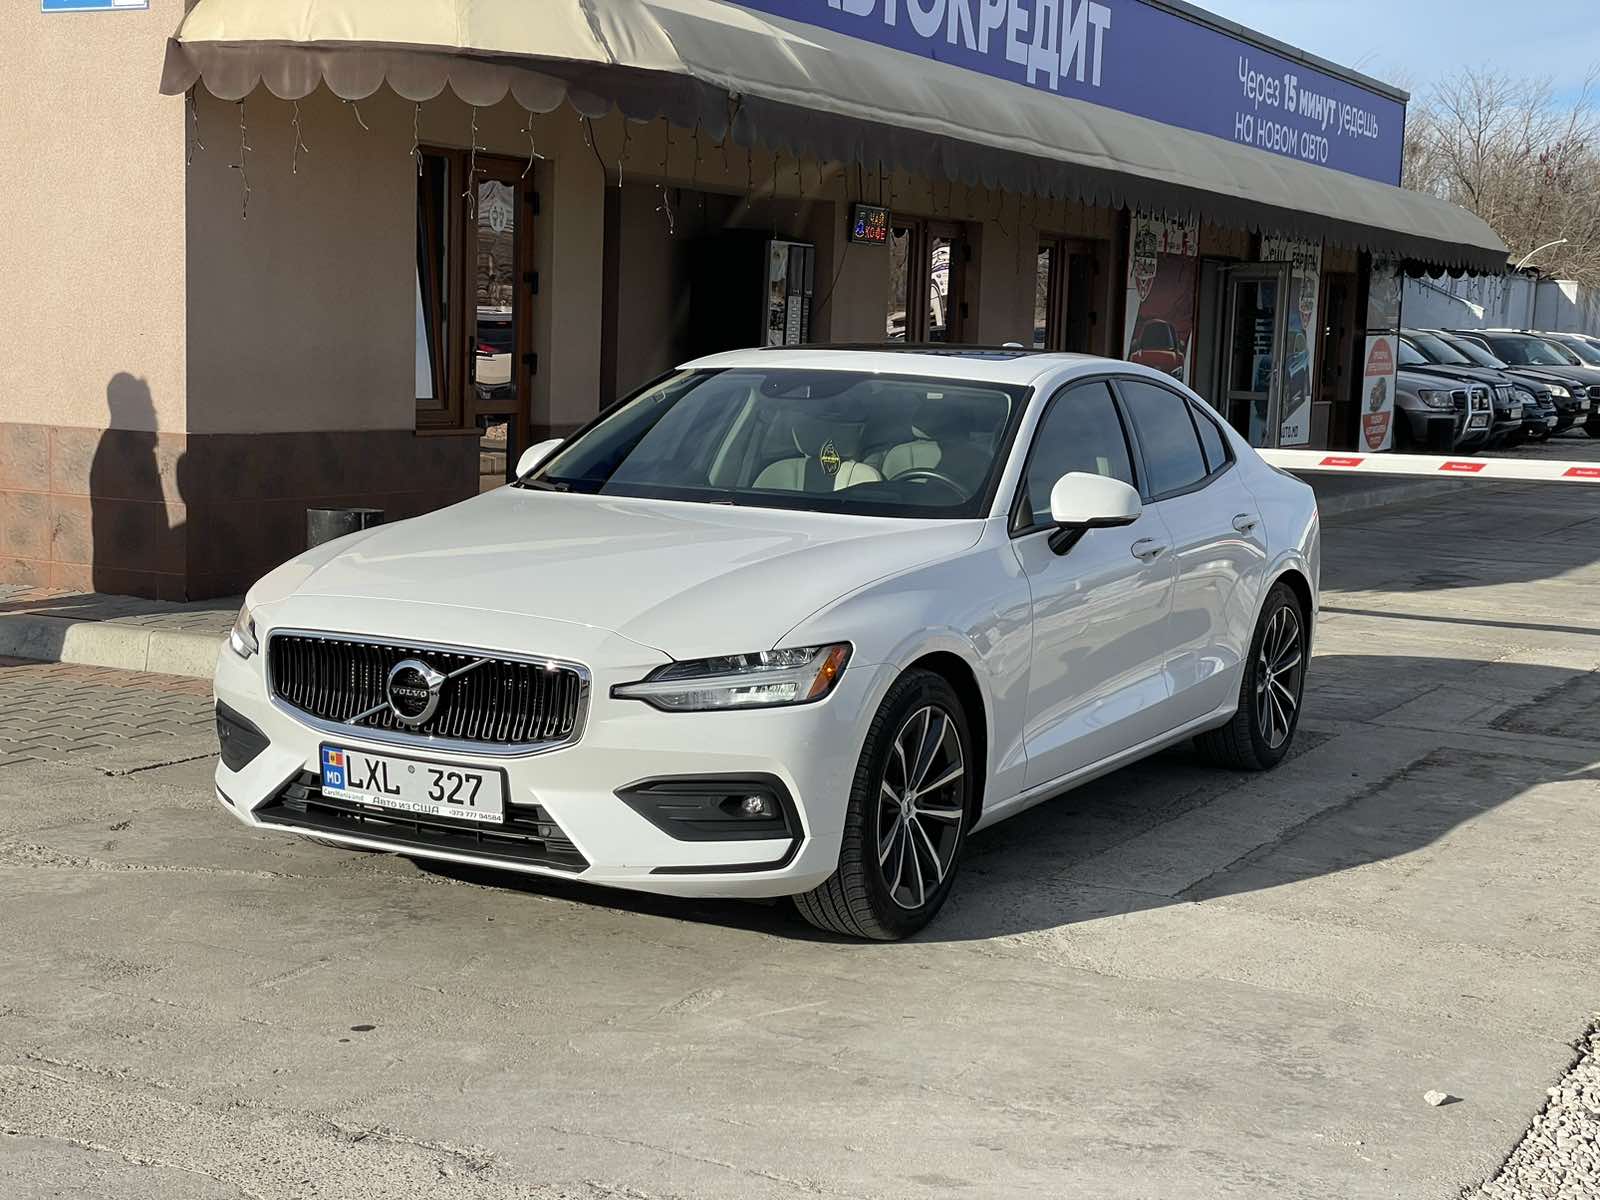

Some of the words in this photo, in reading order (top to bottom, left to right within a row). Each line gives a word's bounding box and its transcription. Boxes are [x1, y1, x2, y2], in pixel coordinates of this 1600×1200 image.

[827, 0, 1112, 91] КРЕДИТ
[1238, 56, 1280, 110] Через
[1284, 73, 1298, 112] 15
[1299, 88, 1337, 131] минут
[1337, 101, 1379, 138] уедешь
[1234, 111, 1254, 143] на
[1256, 118, 1298, 155] новом
[1300, 131, 1329, 163] авто
[865, 225, 886, 240] КОФЕ
[391, 687, 427, 698] VOLVO
[326, 770, 341, 785] MD
[346, 755, 401, 795] LXL
[428, 767, 483, 806] 327
[372, 796, 397, 808] Авто
[398, 801, 411, 810] из
[412, 802, 439, 814] США
